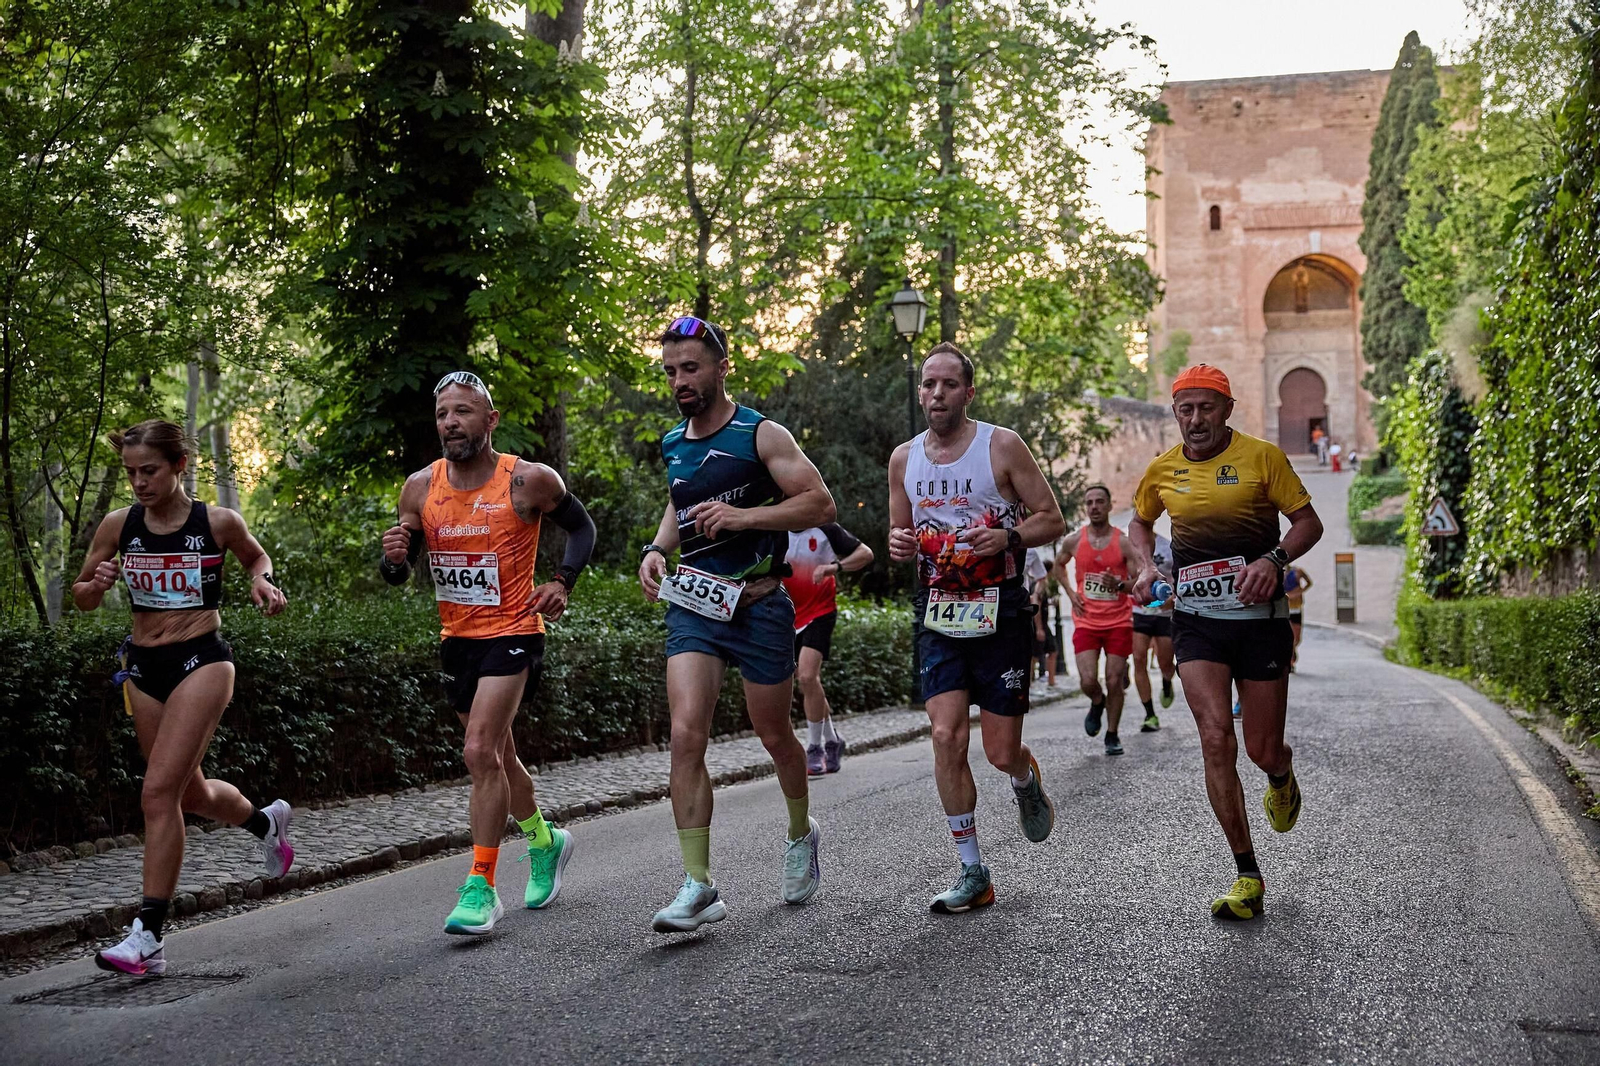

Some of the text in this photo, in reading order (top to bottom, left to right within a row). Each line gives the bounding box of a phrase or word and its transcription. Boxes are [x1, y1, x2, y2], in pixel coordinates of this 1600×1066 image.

[916, 478, 973, 496] GOBIK
[127, 571, 187, 593] 3010
[433, 568, 488, 589] 3464
[1181, 569, 1190, 581] 41
[666, 573, 728, 605] 4355
[1180, 575, 1236, 598] 2897
[929, 603, 985, 622] 1474
